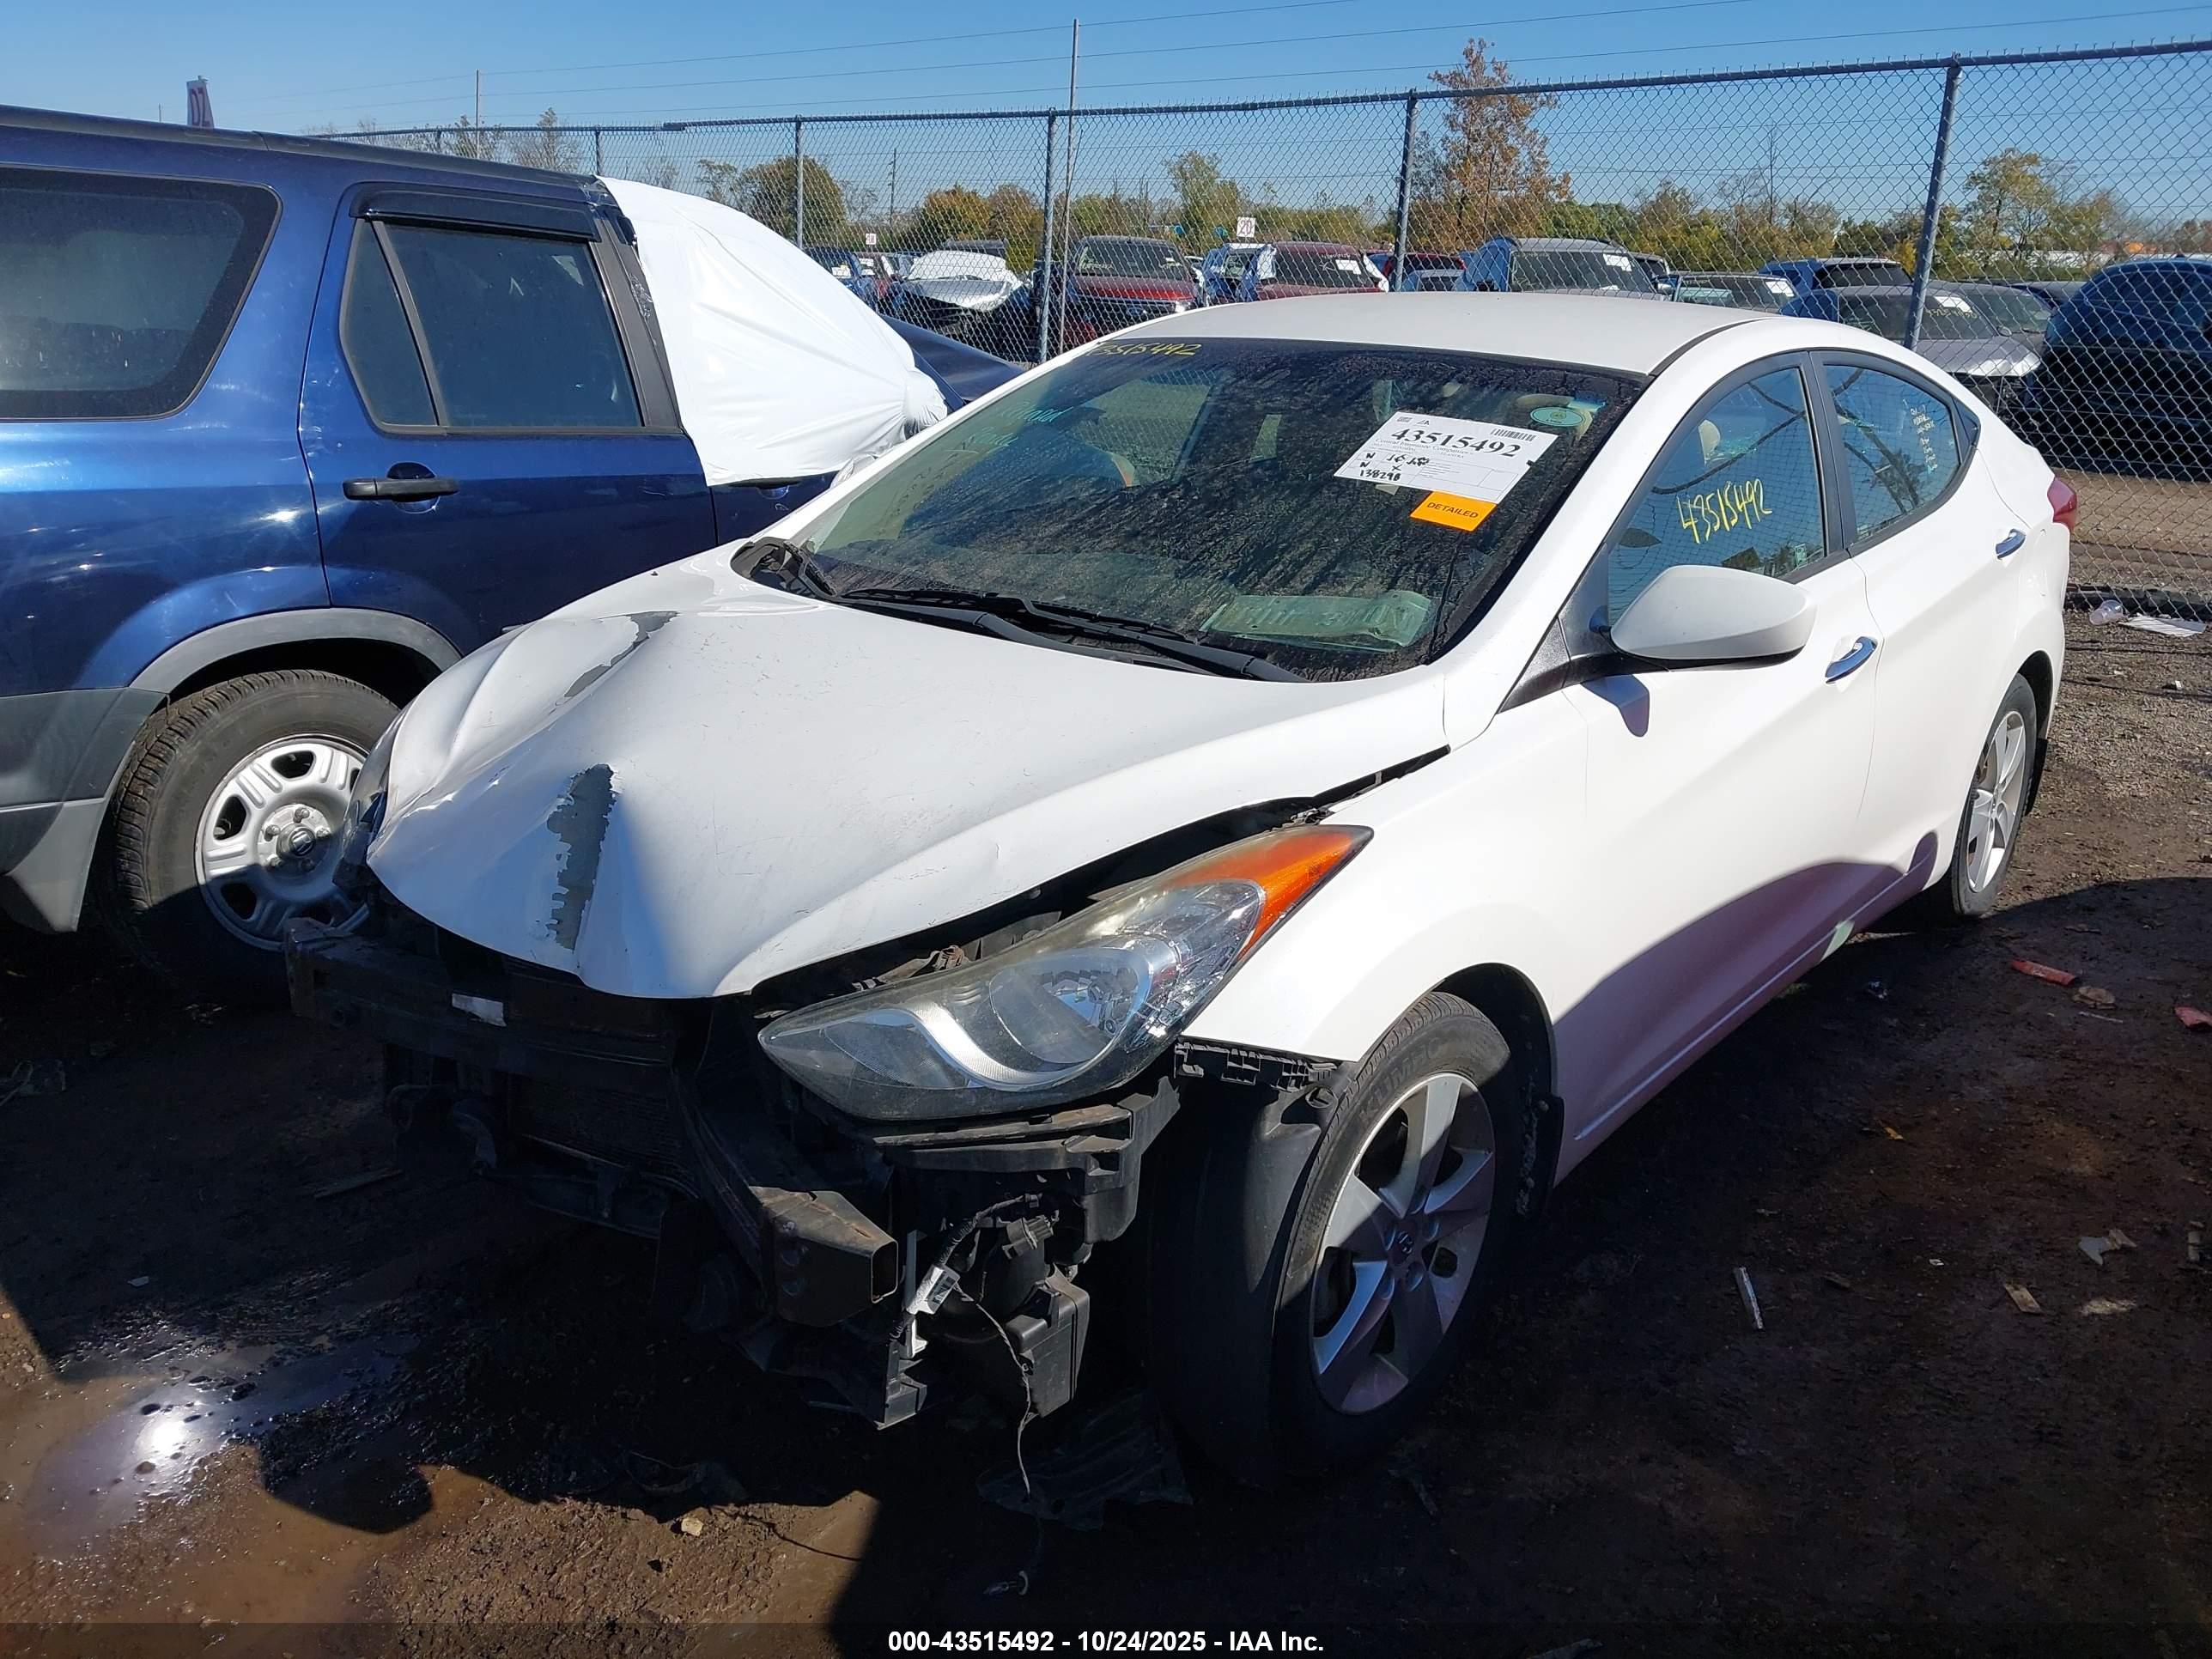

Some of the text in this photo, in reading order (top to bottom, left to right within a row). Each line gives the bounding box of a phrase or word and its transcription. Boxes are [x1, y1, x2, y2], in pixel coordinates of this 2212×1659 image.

[1391, 428, 1521, 458] 43515492
[1426, 501, 1479, 520] DETAILED
[1676, 478, 1773, 544] 43515492
